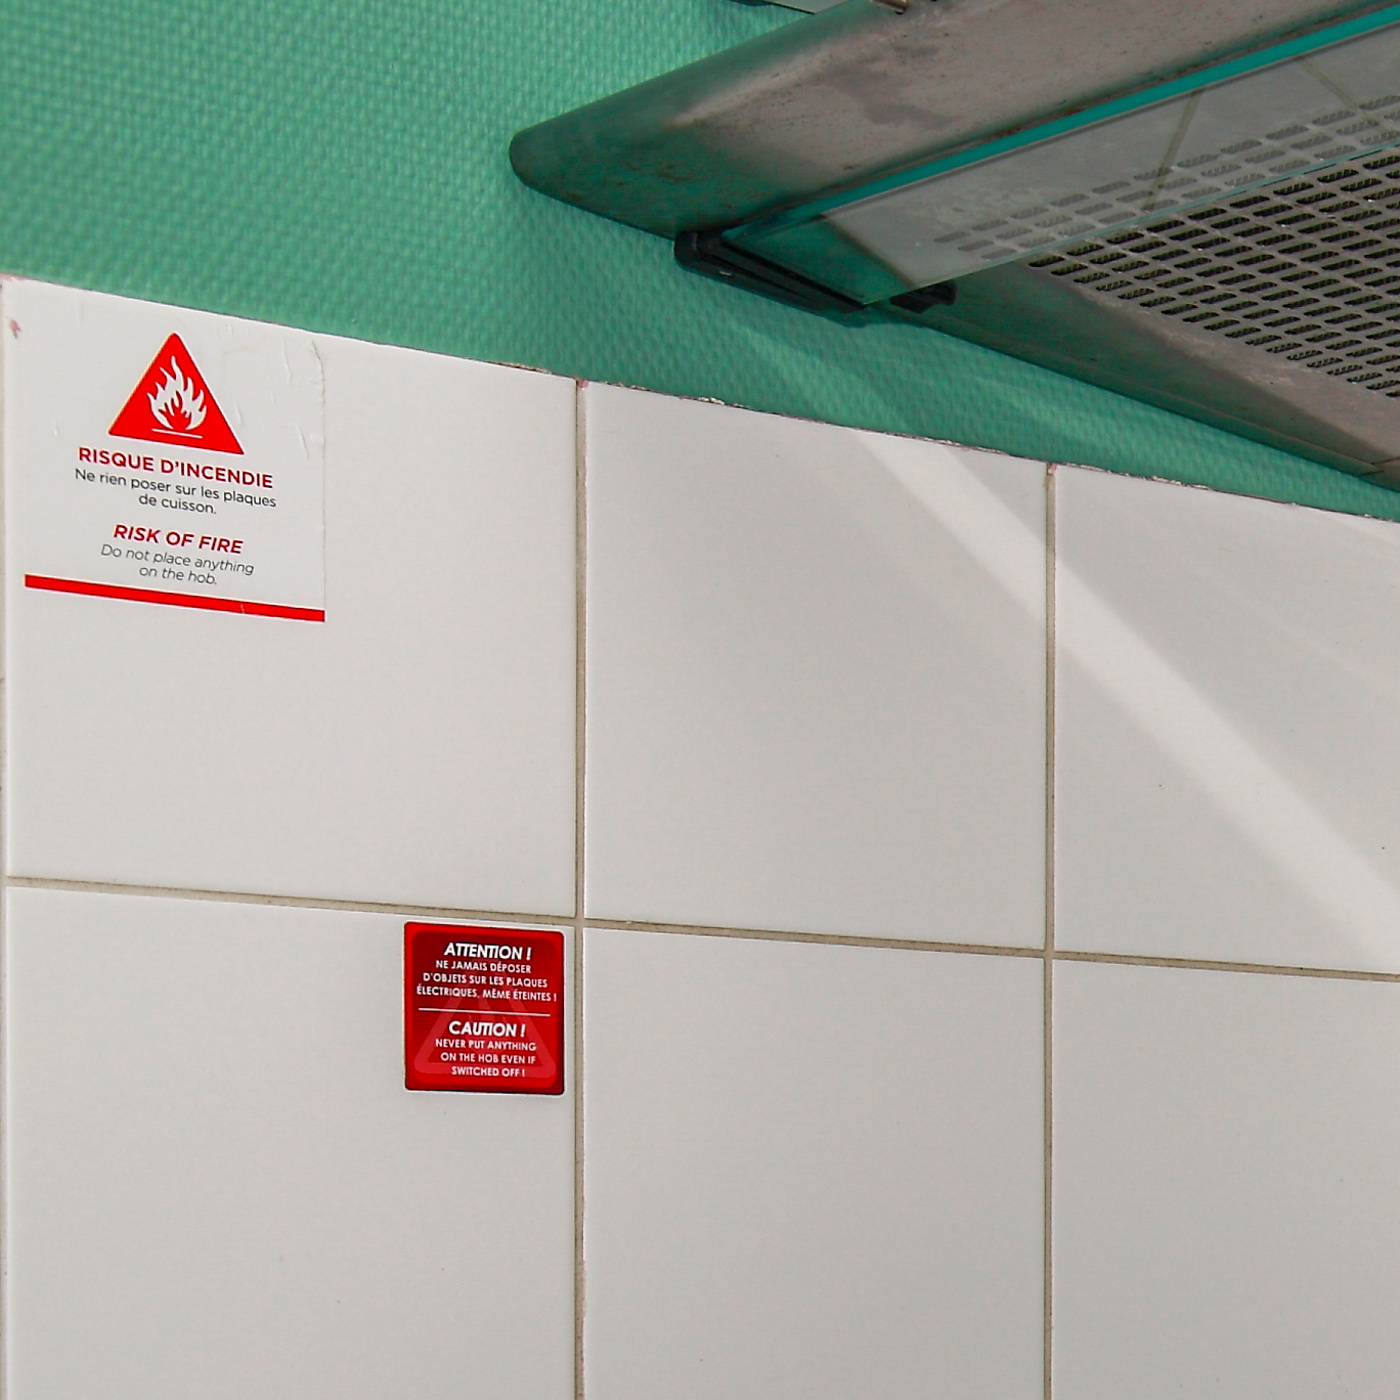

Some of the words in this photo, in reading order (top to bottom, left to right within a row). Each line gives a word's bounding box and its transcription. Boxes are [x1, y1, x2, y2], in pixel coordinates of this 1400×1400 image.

[78, 447, 153, 471] RISQUE
[161, 459, 273, 488] D'INCENDIE
[75, 468, 95, 481] Ne
[99, 471, 126, 486] rien
[131, 477, 171, 497] poser
[175, 484, 197, 497] sur
[201, 486, 219, 499] les
[223, 490, 276, 508] plaques
[139, 493, 157, 506] de
[161, 497, 217, 514] cuisson.
[113, 524, 160, 543] RISK
[166, 531, 194, 546] OF
[199, 536, 243, 554] FIRE
[101, 544, 121, 557] Do
[126, 548, 150, 562] not
[153, 551, 191, 567] place
[195, 558, 254, 576] anything
[139, 566, 158, 577] on
[162, 567, 184, 580] the
[188, 570, 217, 585] hob.
[444, 942, 522, 960] ATTENTION
[435, 960, 448, 969] NE
[451, 961, 487, 971] JAMAIS
[490, 961, 531, 973] DÉPOSER
[423, 972, 467, 983] D'OBJETS
[469, 975, 486, 985] SUR
[489, 976, 503, 985] LES
[507, 977, 547, 988] PLAQUES
[483, 988, 510, 999] MÊME
[513, 990, 551, 1001] ÉTEINTES
[449, 1021, 516, 1037] CAUTION
[435, 1039, 466, 1049] NEVER
[468, 1040, 485, 1049] PUT
[487, 1041, 537, 1051] ANYTHING
[441, 1052, 456, 1062] ON
[460, 1053, 475, 1063] THE
[478, 1054, 498, 1064] HOB
[501, 1055, 525, 1064] EVEN
[528, 1056, 536, 1064] IF
[451, 1066, 499, 1077] SWITCHED
[502, 1068, 520, 1077] OFF
